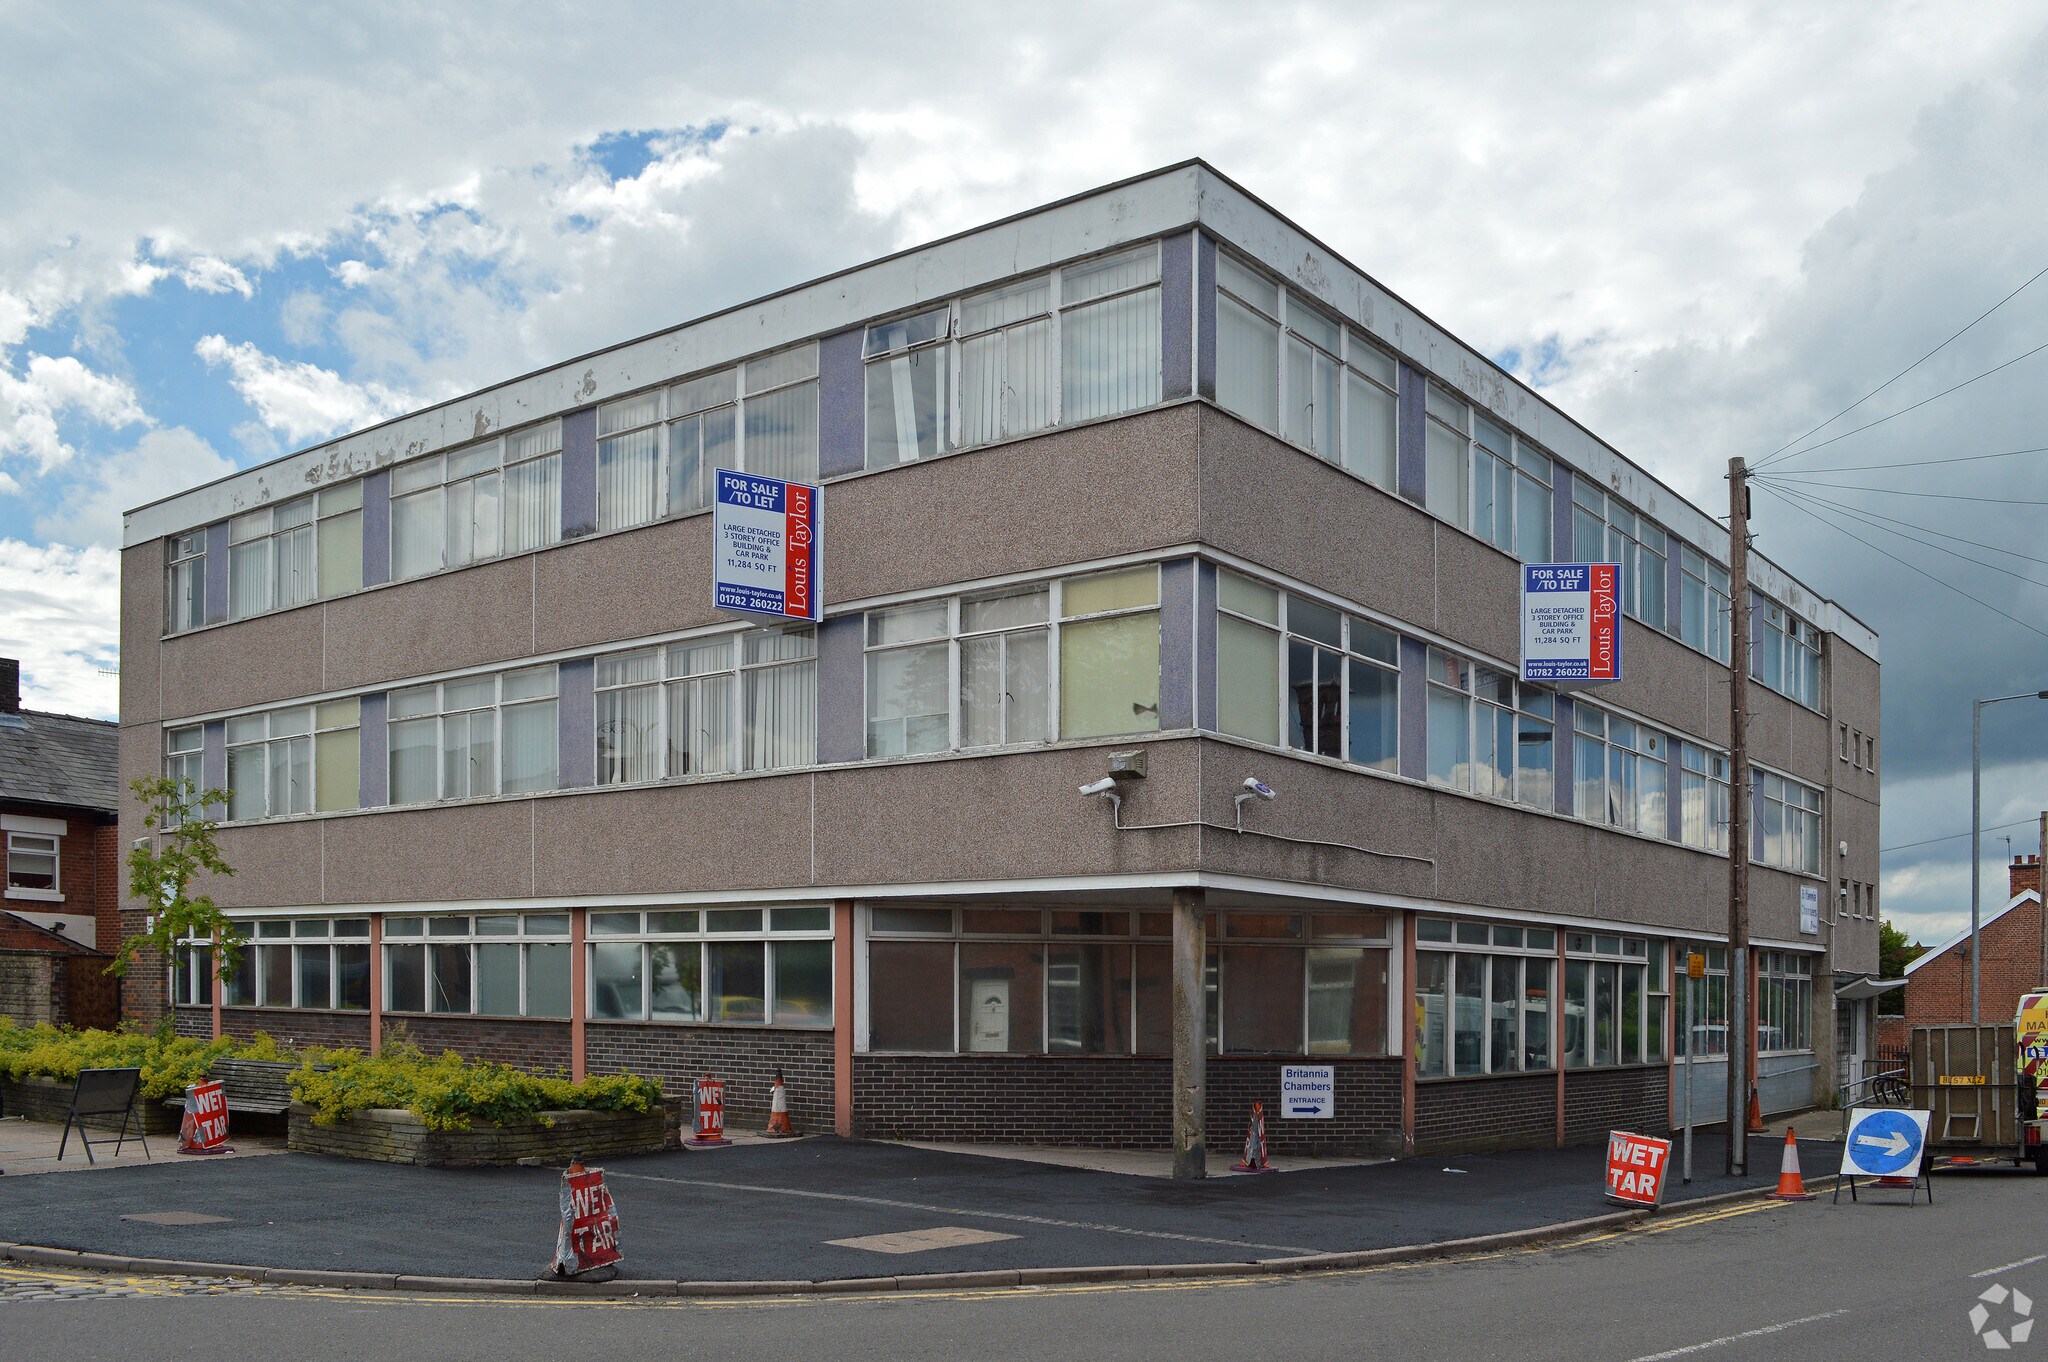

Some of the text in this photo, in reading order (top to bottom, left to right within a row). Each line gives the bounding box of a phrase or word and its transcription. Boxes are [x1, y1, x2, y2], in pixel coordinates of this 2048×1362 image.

[724, 477, 779, 497] FOR SALE
[728, 490, 775, 509] /TO LET
[723, 523, 781, 539] LARGE DETACHED
[724, 531, 780, 547] 3 STOREY OFFICE
[732, 541, 765, 552] BUILDING
[789, 492, 813, 610] Louis Taylor
[735, 549, 769, 561] CAR PARK
[754, 562, 766, 572] SQ
[767, 564, 777, 573] FT
[1532, 569, 1583, 579] FOR SALE
[1536, 579, 1579, 590] /TO LET
[719, 586, 783, 600] www.louis-taylor.co.uk
[719, 593, 783, 611] 01782 260222
[1593, 570, 1617, 672] Louis Taylor
[1534, 637, 1557, 645] 11,284
[1527, 660, 1588, 668] www.louis-taylor.co.uk
[1527, 668, 1588, 677] 01782 260222
[2026, 1021, 2048, 1031] MA
[1286, 1069, 1329, 1078] Britannia
[1283, 1081, 1331, 1091] Chambers
[195, 1089, 223, 1115] WET
[201, 1115, 227, 1141] TAR
[1613, 1140, 1665, 1169] WET
[1610, 1168, 1656, 1197] TAR
[571, 1184, 607, 1219] WET
[574, 1220, 615, 1254] TAR
